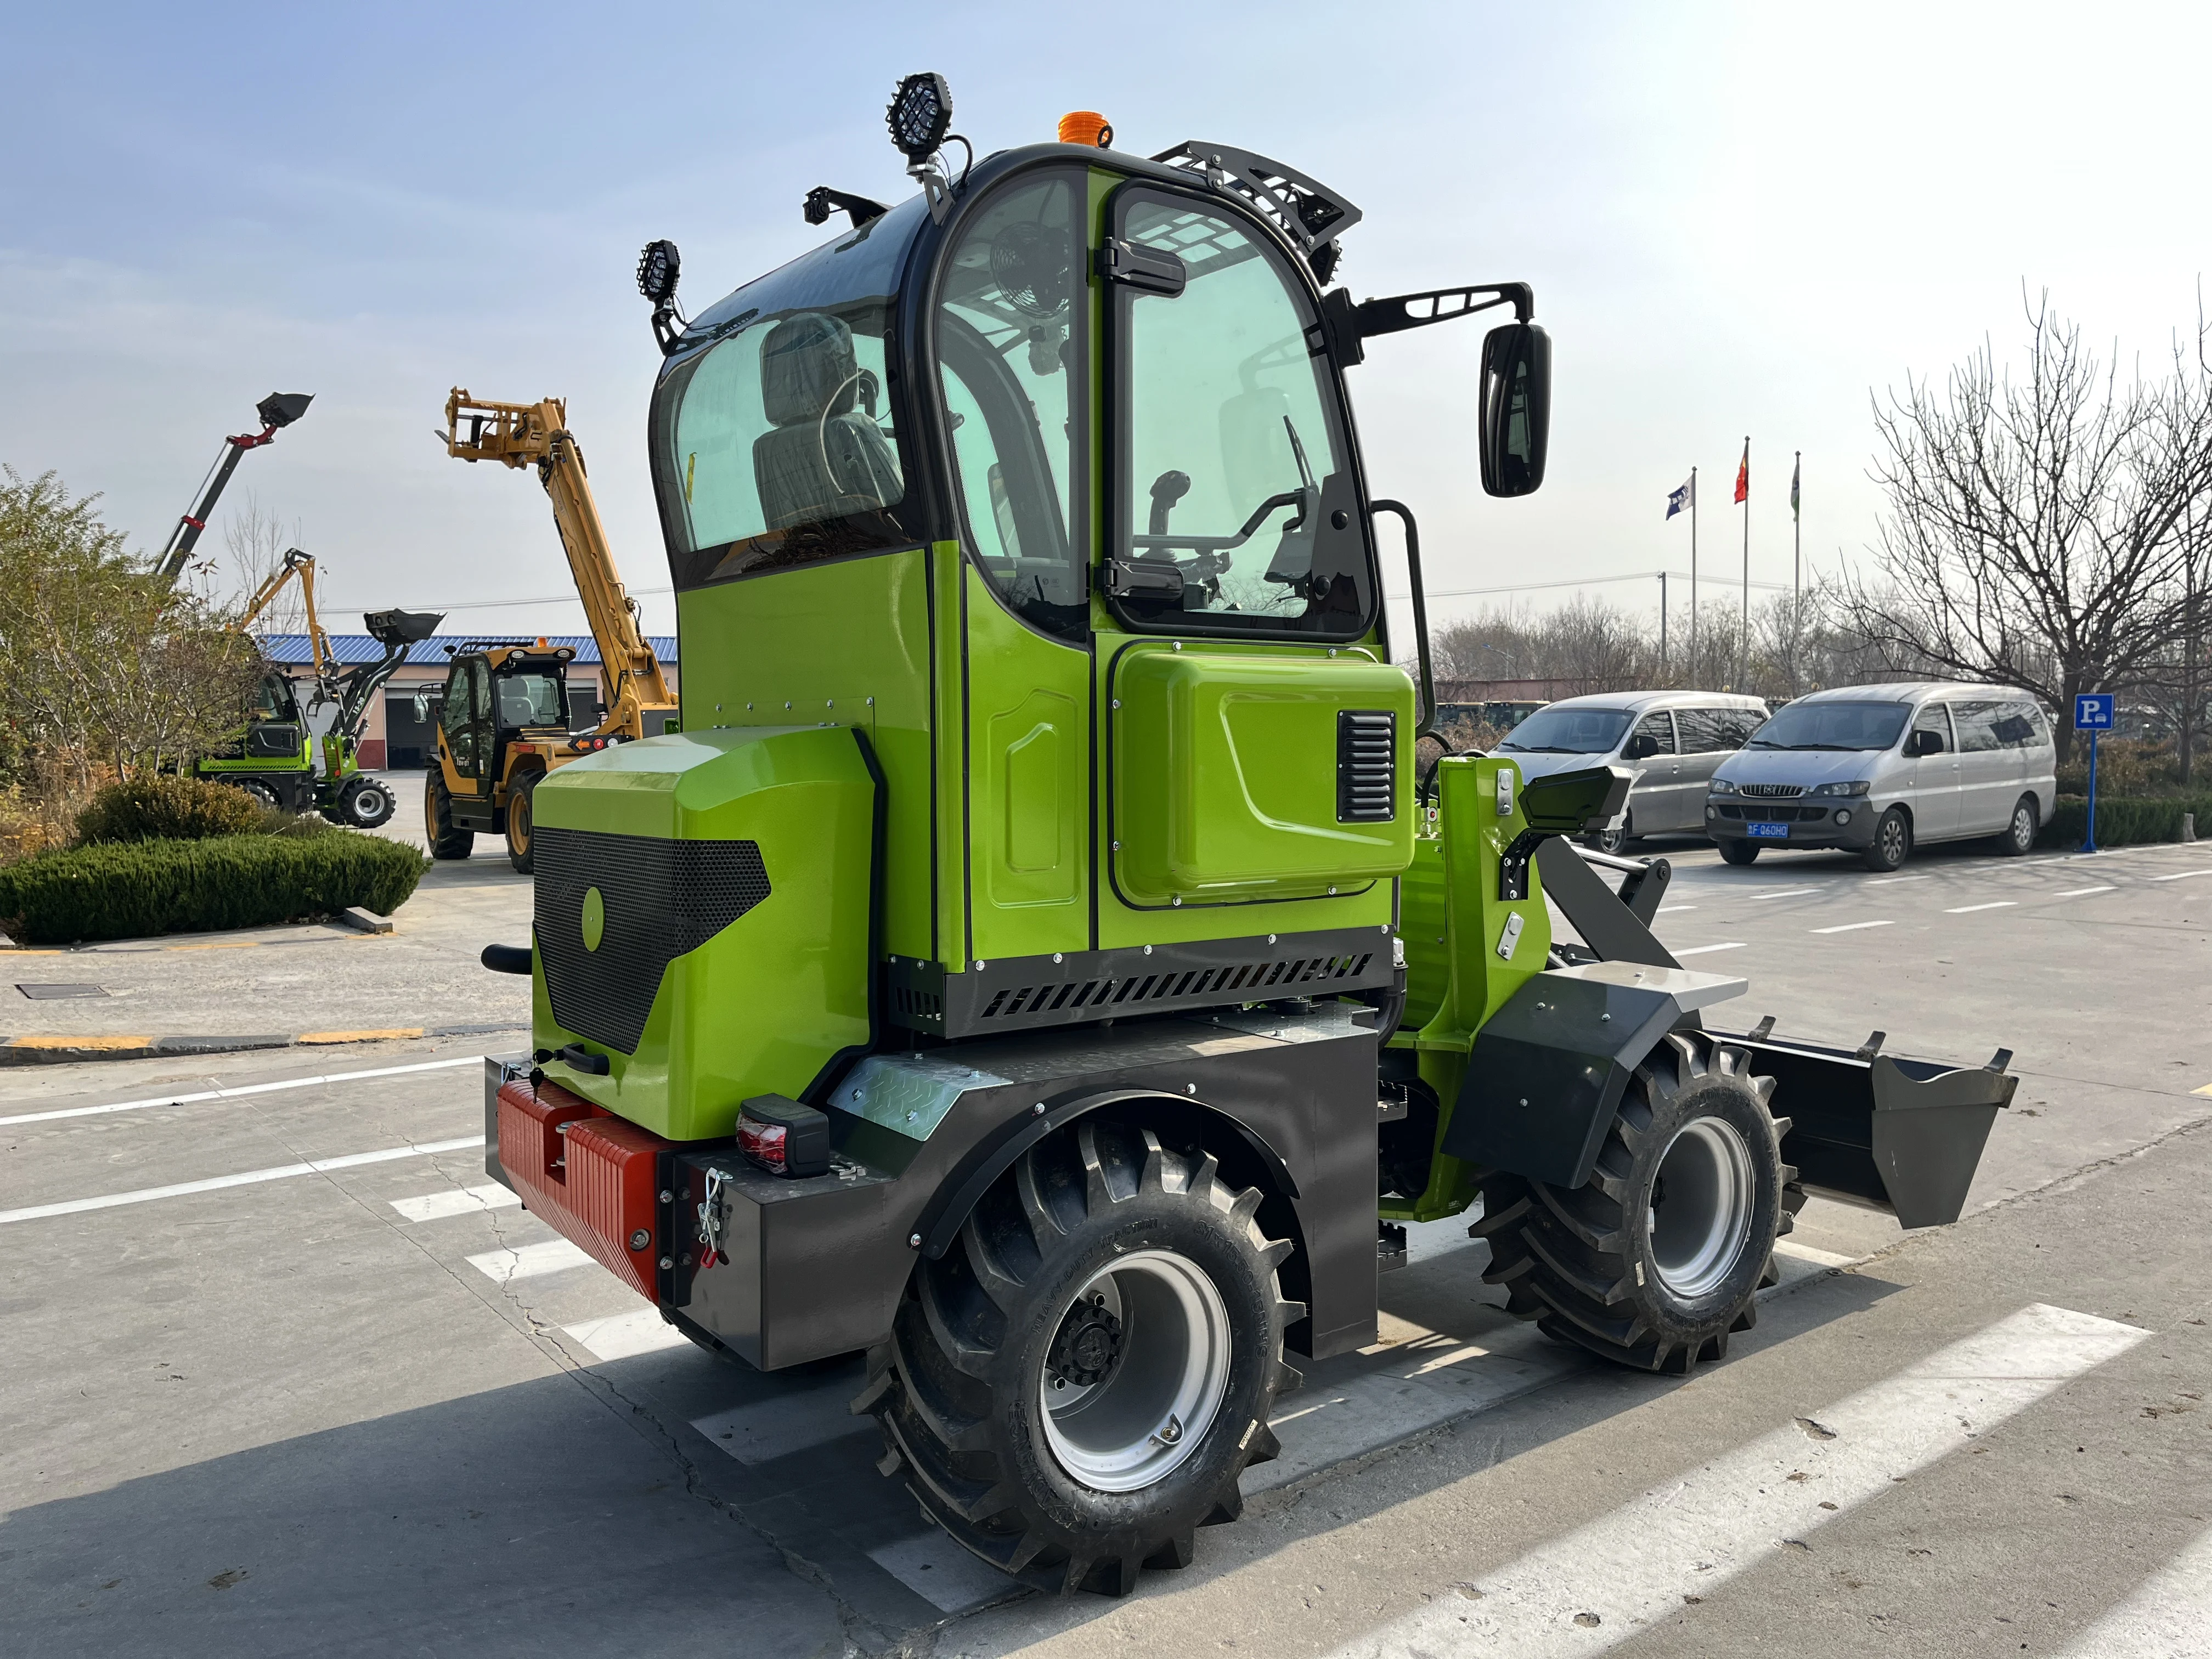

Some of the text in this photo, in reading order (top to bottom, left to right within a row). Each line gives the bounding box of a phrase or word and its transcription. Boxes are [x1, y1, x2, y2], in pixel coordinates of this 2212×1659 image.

[2080, 700, 2100, 724] P
[1031, 1217, 1159, 1334] HEAVY DUTY TRACTION
[1008, 1406, 1058, 1508] ADVANCE
